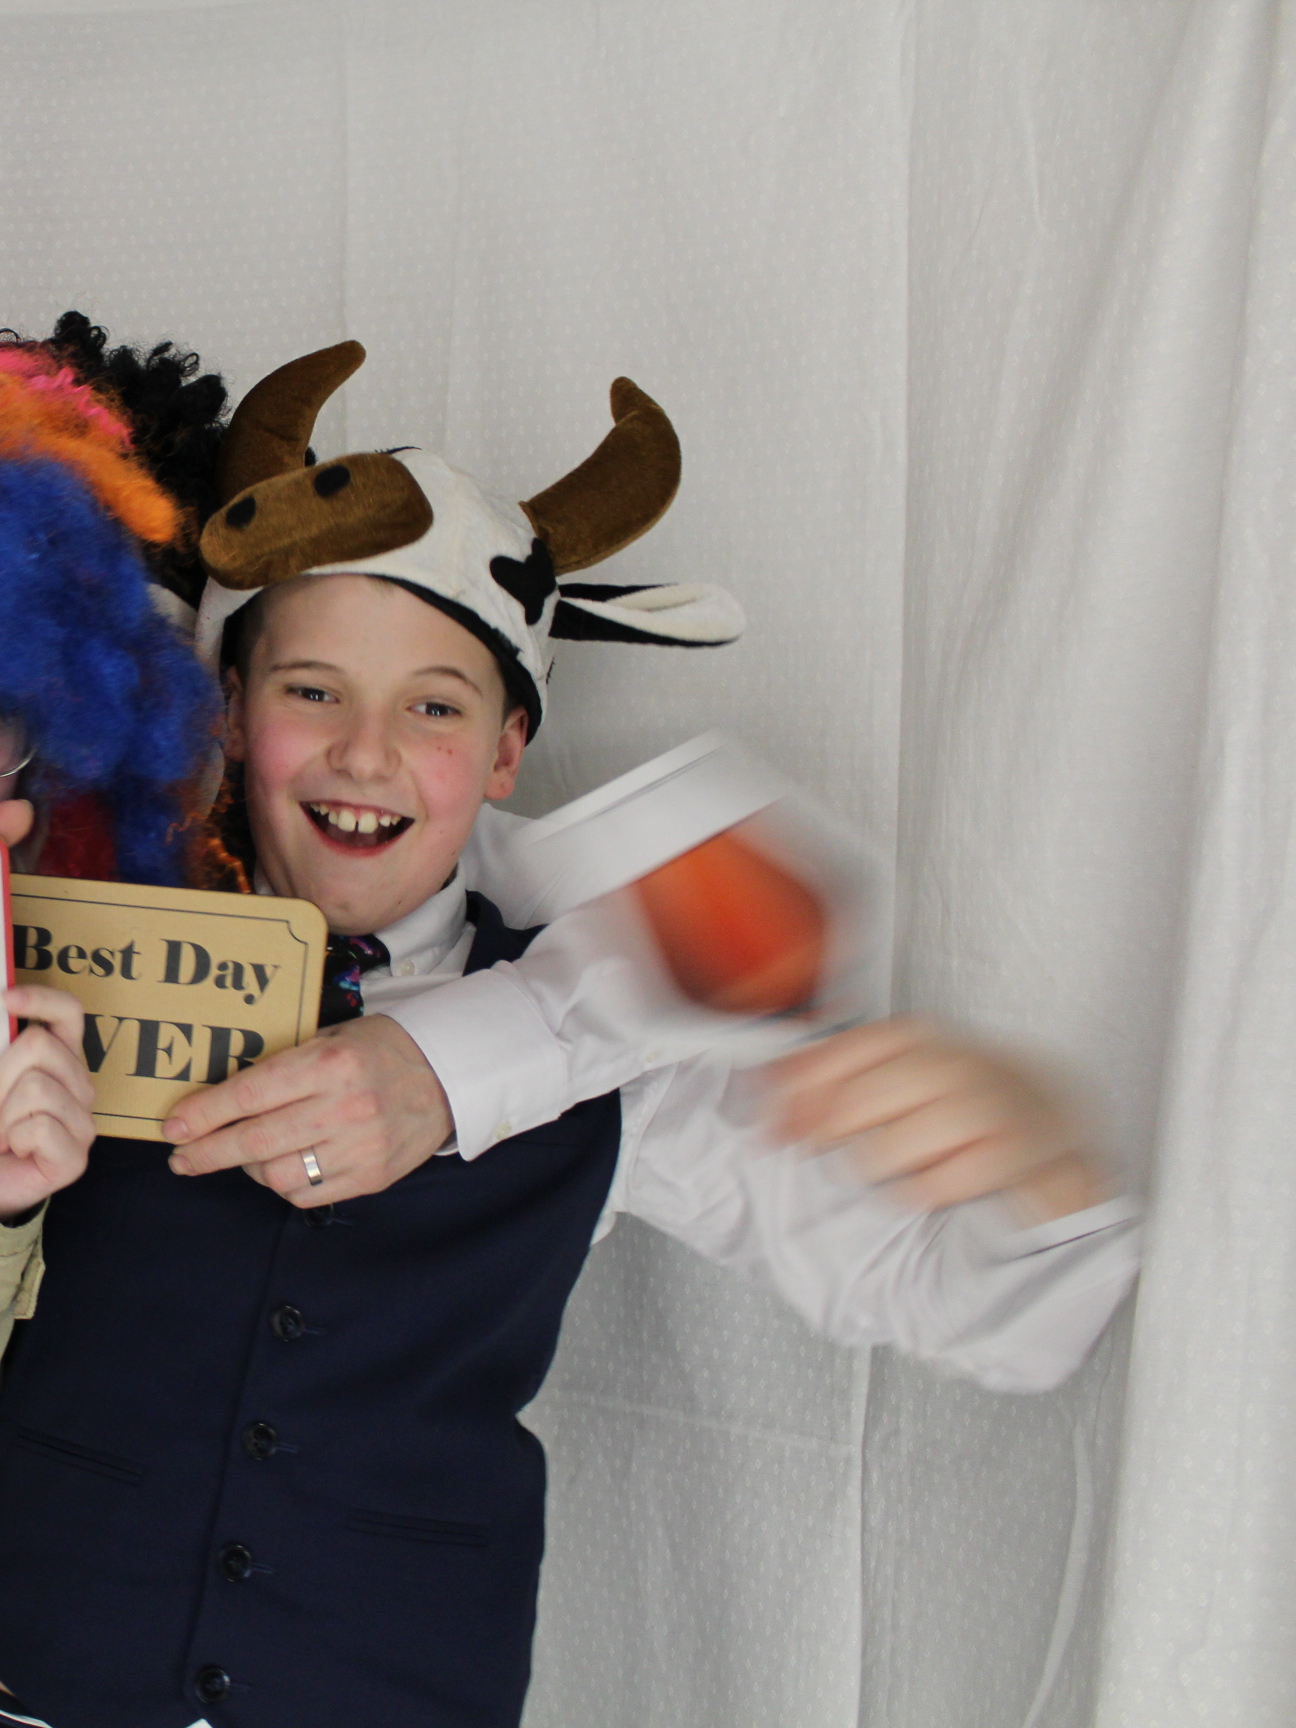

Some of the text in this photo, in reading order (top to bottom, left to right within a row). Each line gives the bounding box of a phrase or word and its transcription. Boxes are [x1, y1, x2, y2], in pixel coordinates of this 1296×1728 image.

[11, 923, 282, 1006] Best Day
[16, 1012, 265, 1085] VER
